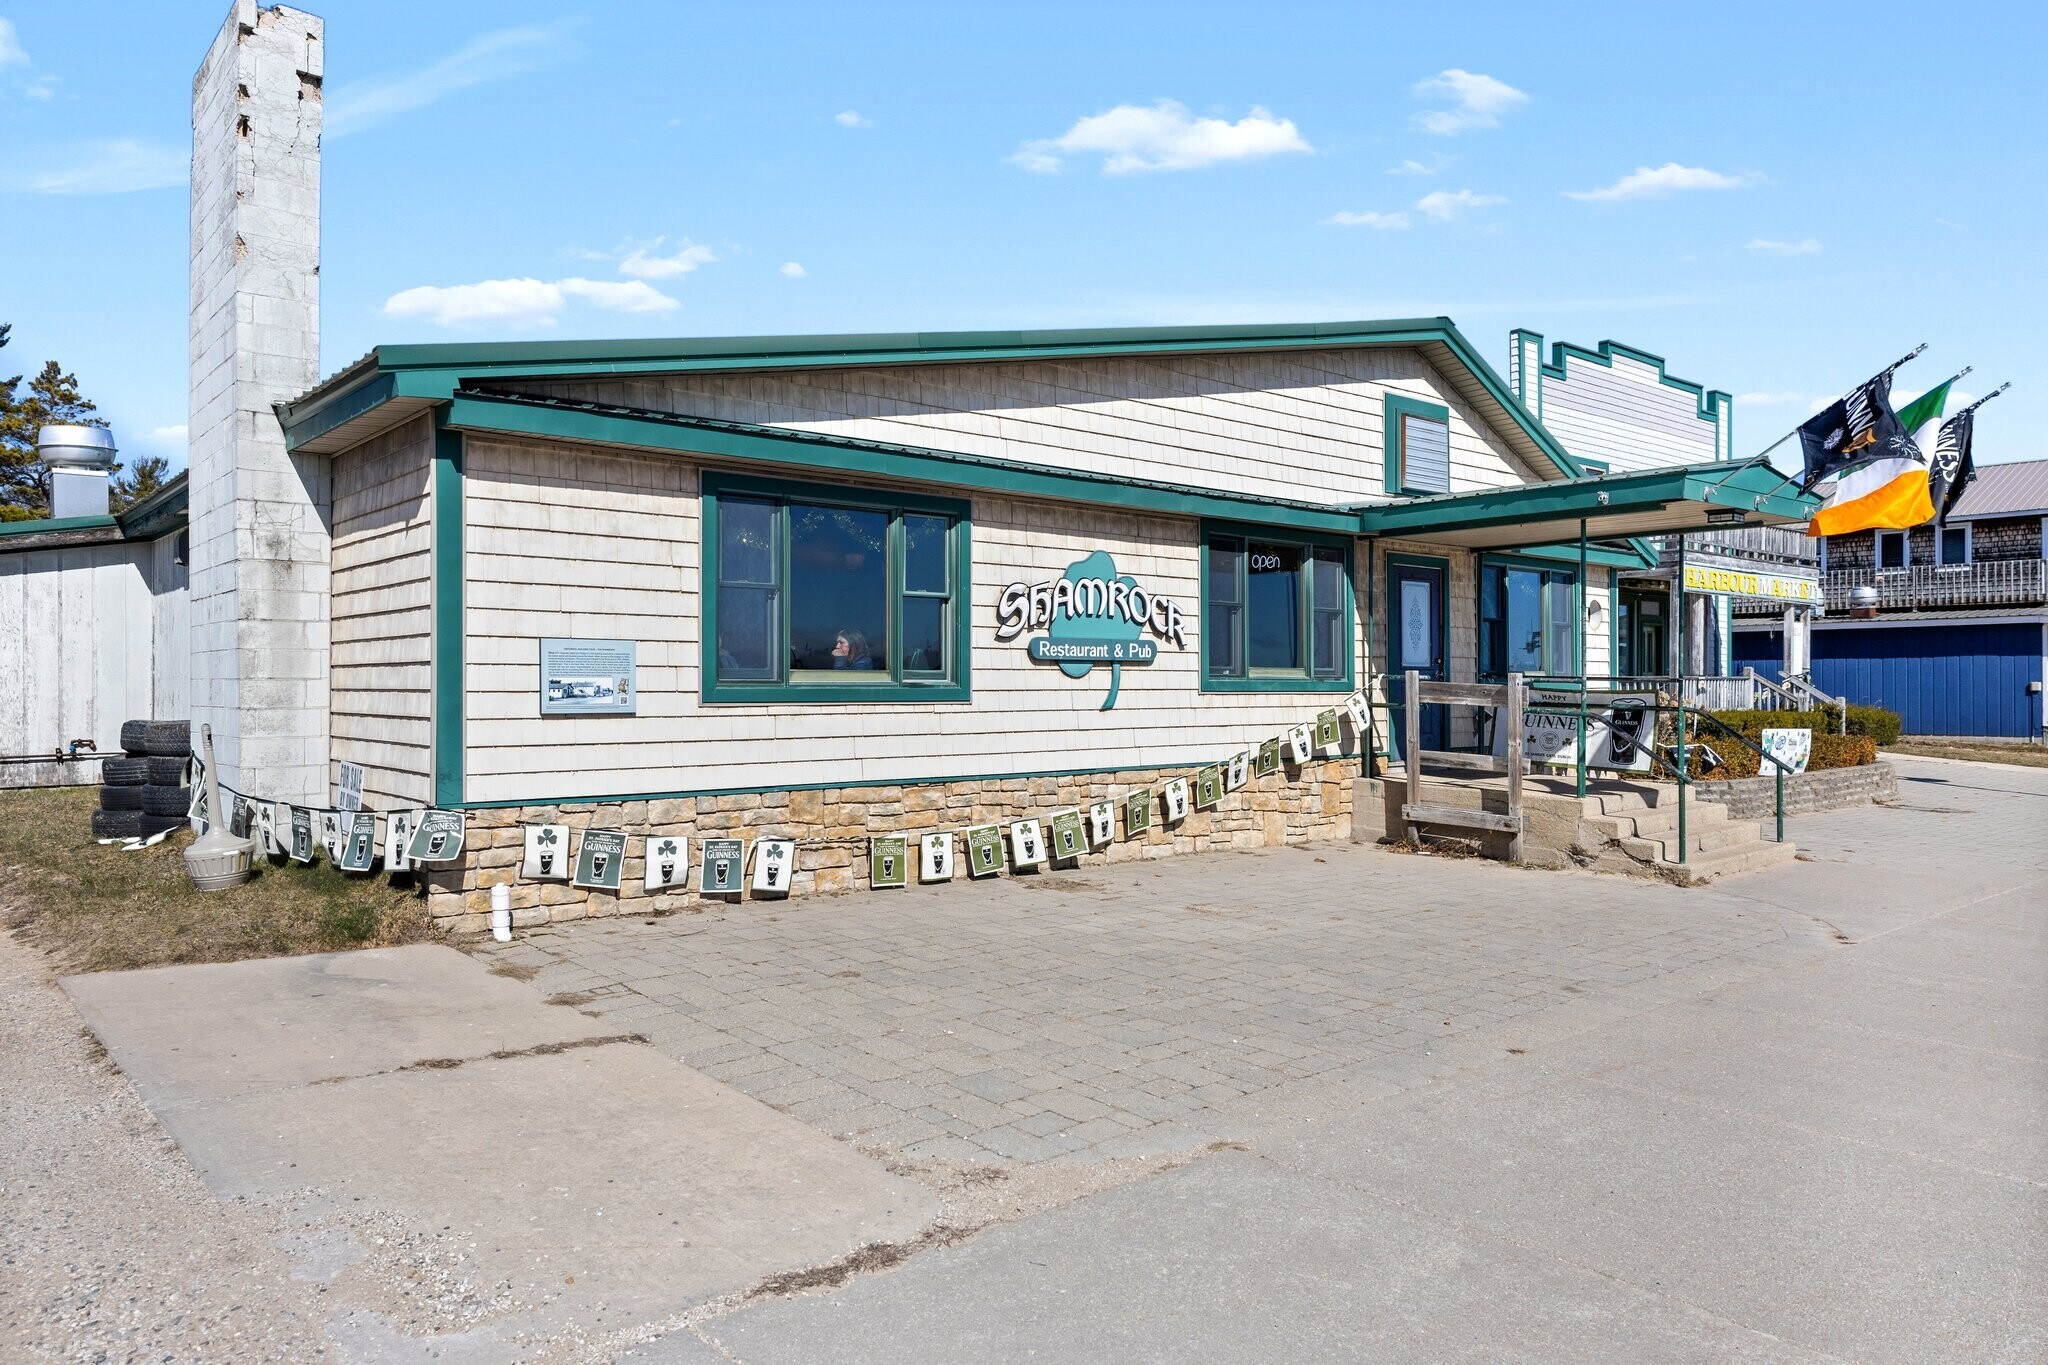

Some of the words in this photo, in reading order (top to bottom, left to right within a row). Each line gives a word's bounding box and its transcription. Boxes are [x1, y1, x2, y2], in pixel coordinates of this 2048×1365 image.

[1685, 567, 1759, 595] HARBOUR
[1760, 577, 1818, 600] MARKET
[996, 577, 1187, 647] SHAMROCK
[1039, 641, 1109, 659] Restaurant
[1114, 643, 1124, 658] &
[1129, 643, 1152, 659] Pub
[1541, 693, 1567, 702] HAPPY
[340, 763, 350, 789] FOR
[350, 766, 363, 794] SALE
[422, 821, 460, 833] GUINNESS
[584, 840, 622, 854] GUINNESS
[706, 850, 740, 859] GUINNESS
